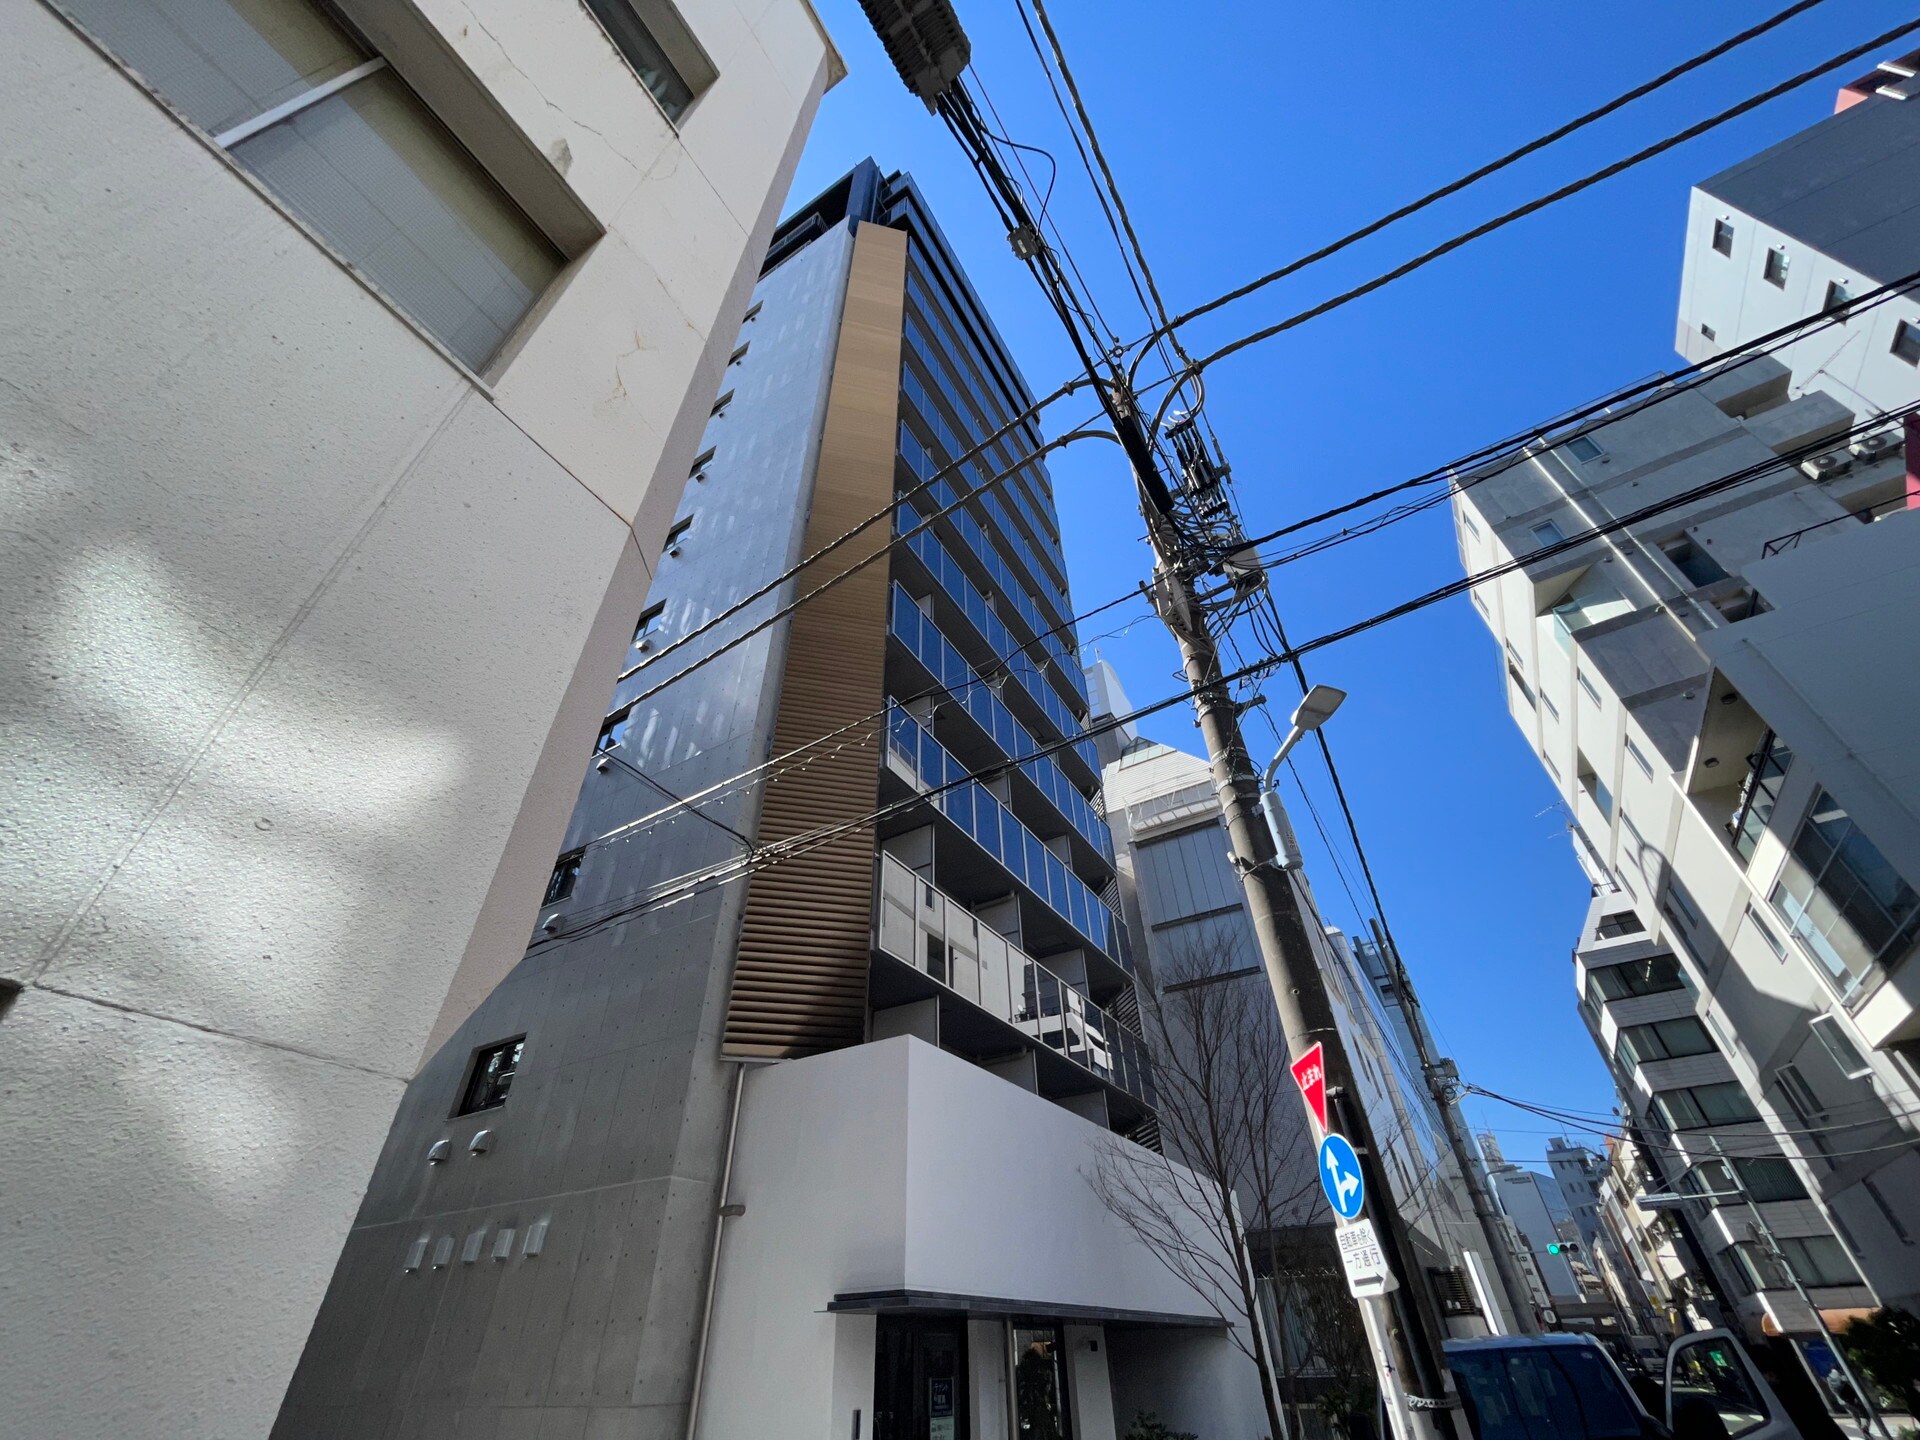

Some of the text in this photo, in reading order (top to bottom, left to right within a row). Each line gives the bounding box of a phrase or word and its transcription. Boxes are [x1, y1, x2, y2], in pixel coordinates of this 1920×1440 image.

[1301, 1064, 1322, 1091] 止まれ
[1346, 1247, 1381, 1269] 一方通行
